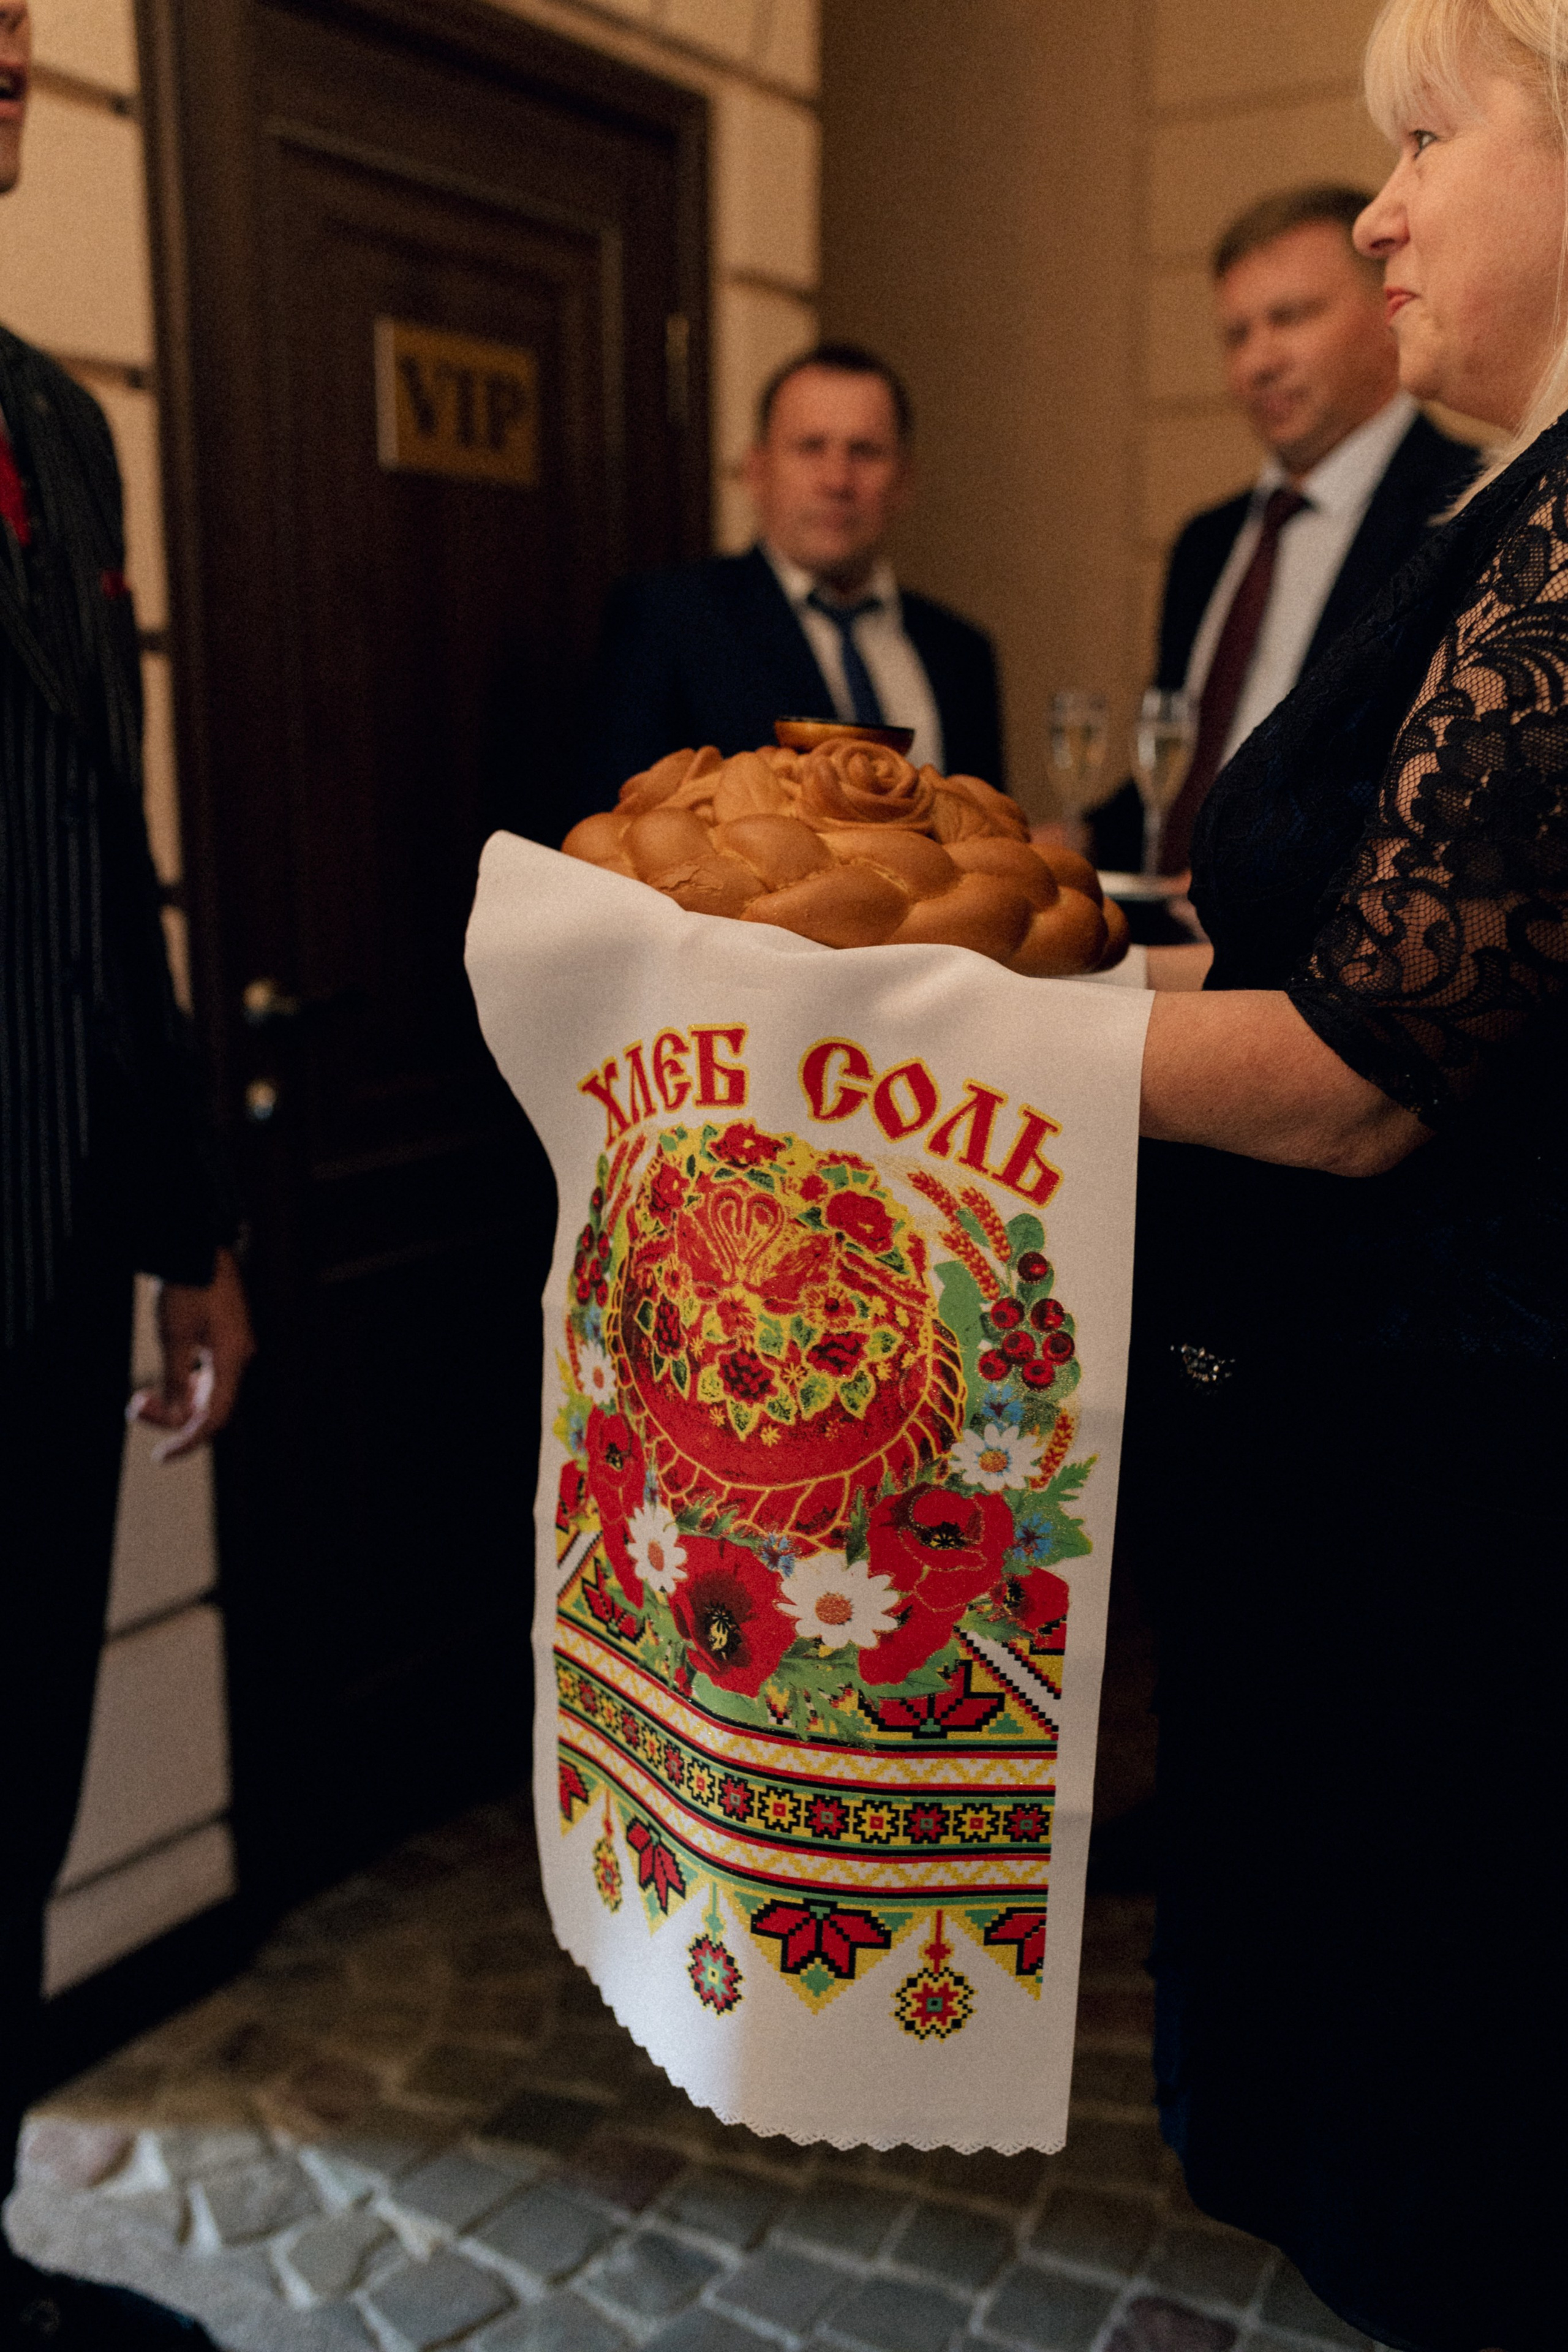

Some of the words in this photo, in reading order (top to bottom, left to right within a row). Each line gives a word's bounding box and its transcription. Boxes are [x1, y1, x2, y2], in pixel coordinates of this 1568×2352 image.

[399, 354, 526, 452] VIP
[578, 1022, 750, 1150] ХЛЕБ
[798, 1036, 1064, 1209] СОЛЬ
